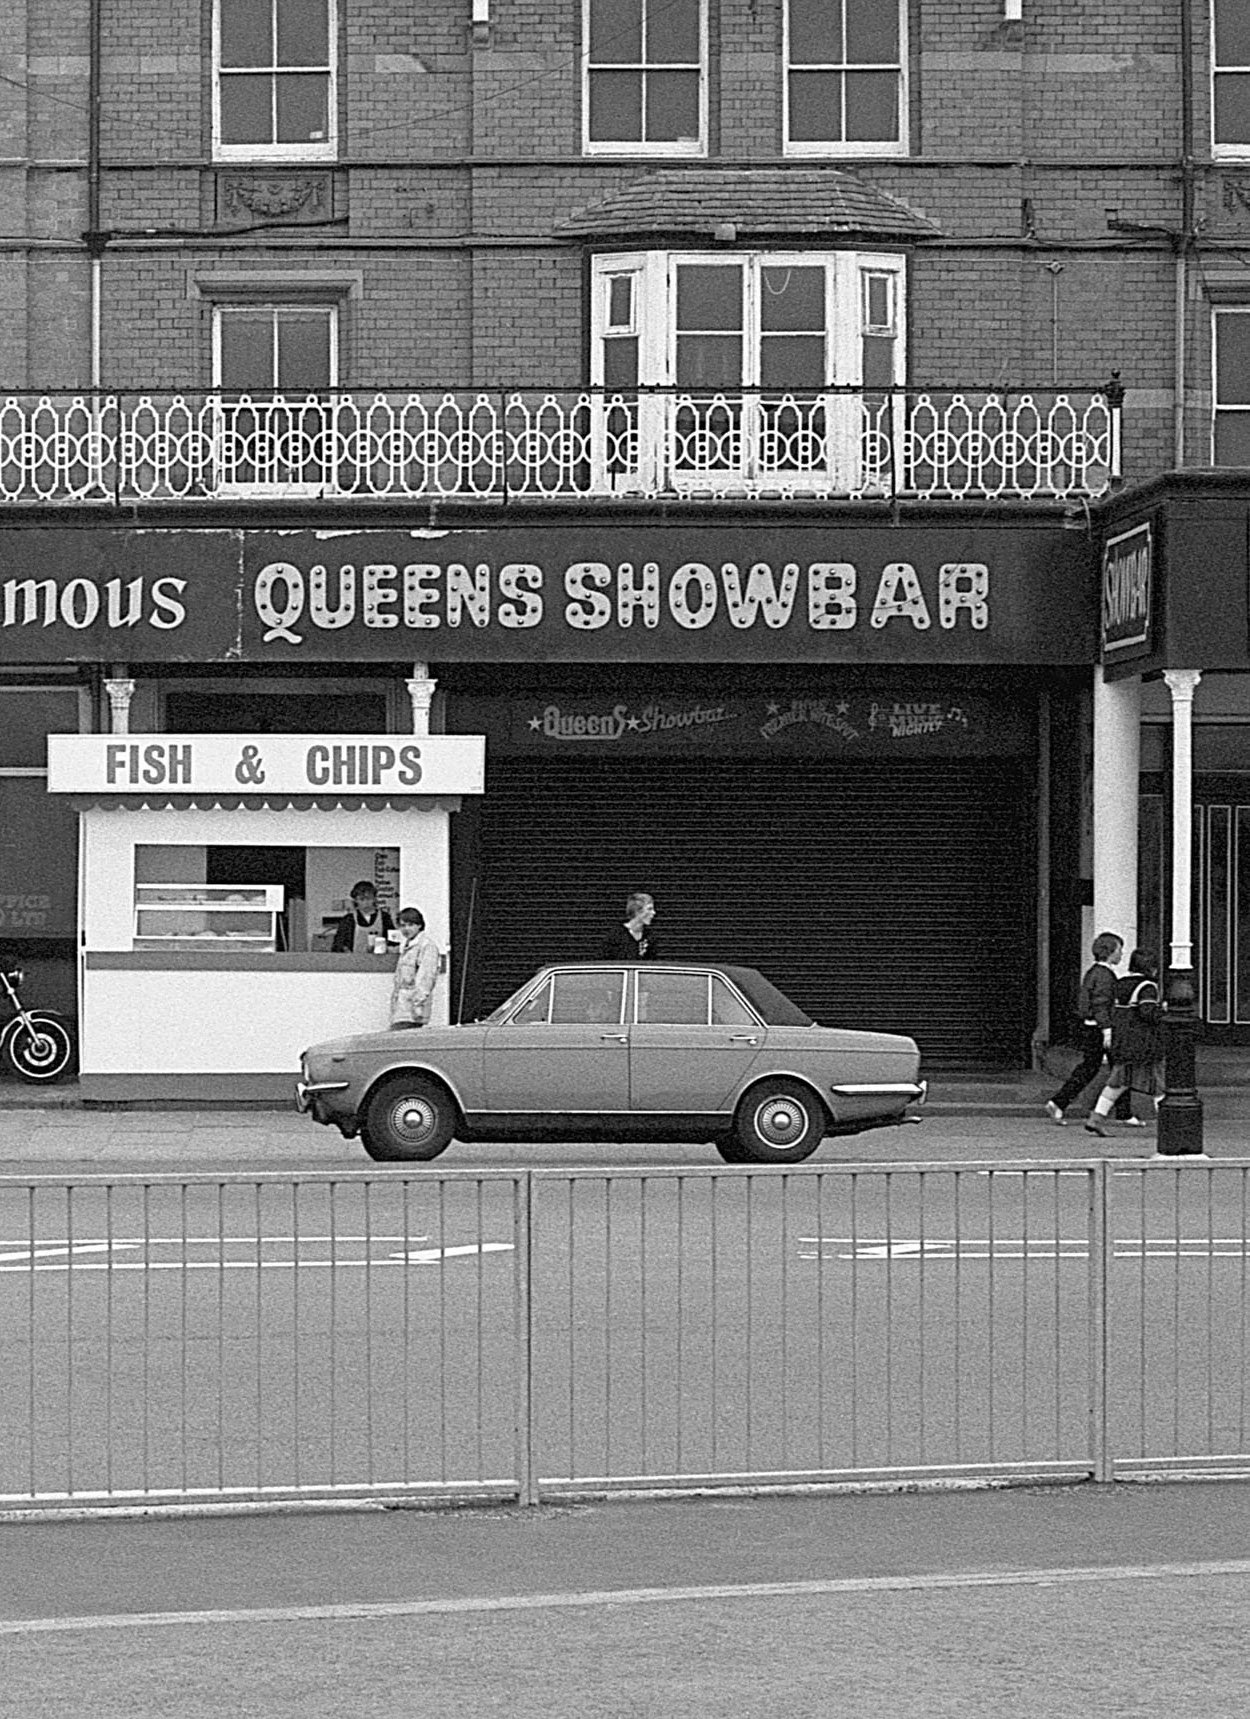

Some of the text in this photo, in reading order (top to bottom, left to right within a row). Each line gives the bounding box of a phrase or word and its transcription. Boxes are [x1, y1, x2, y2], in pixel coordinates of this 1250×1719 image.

[254, 562, 544, 644] QUEENS
[564, 562, 990, 631] SHOWBAR
[892, 703, 941, 715] LIVE
[106, 744, 422, 786] FISH & CHIPS
